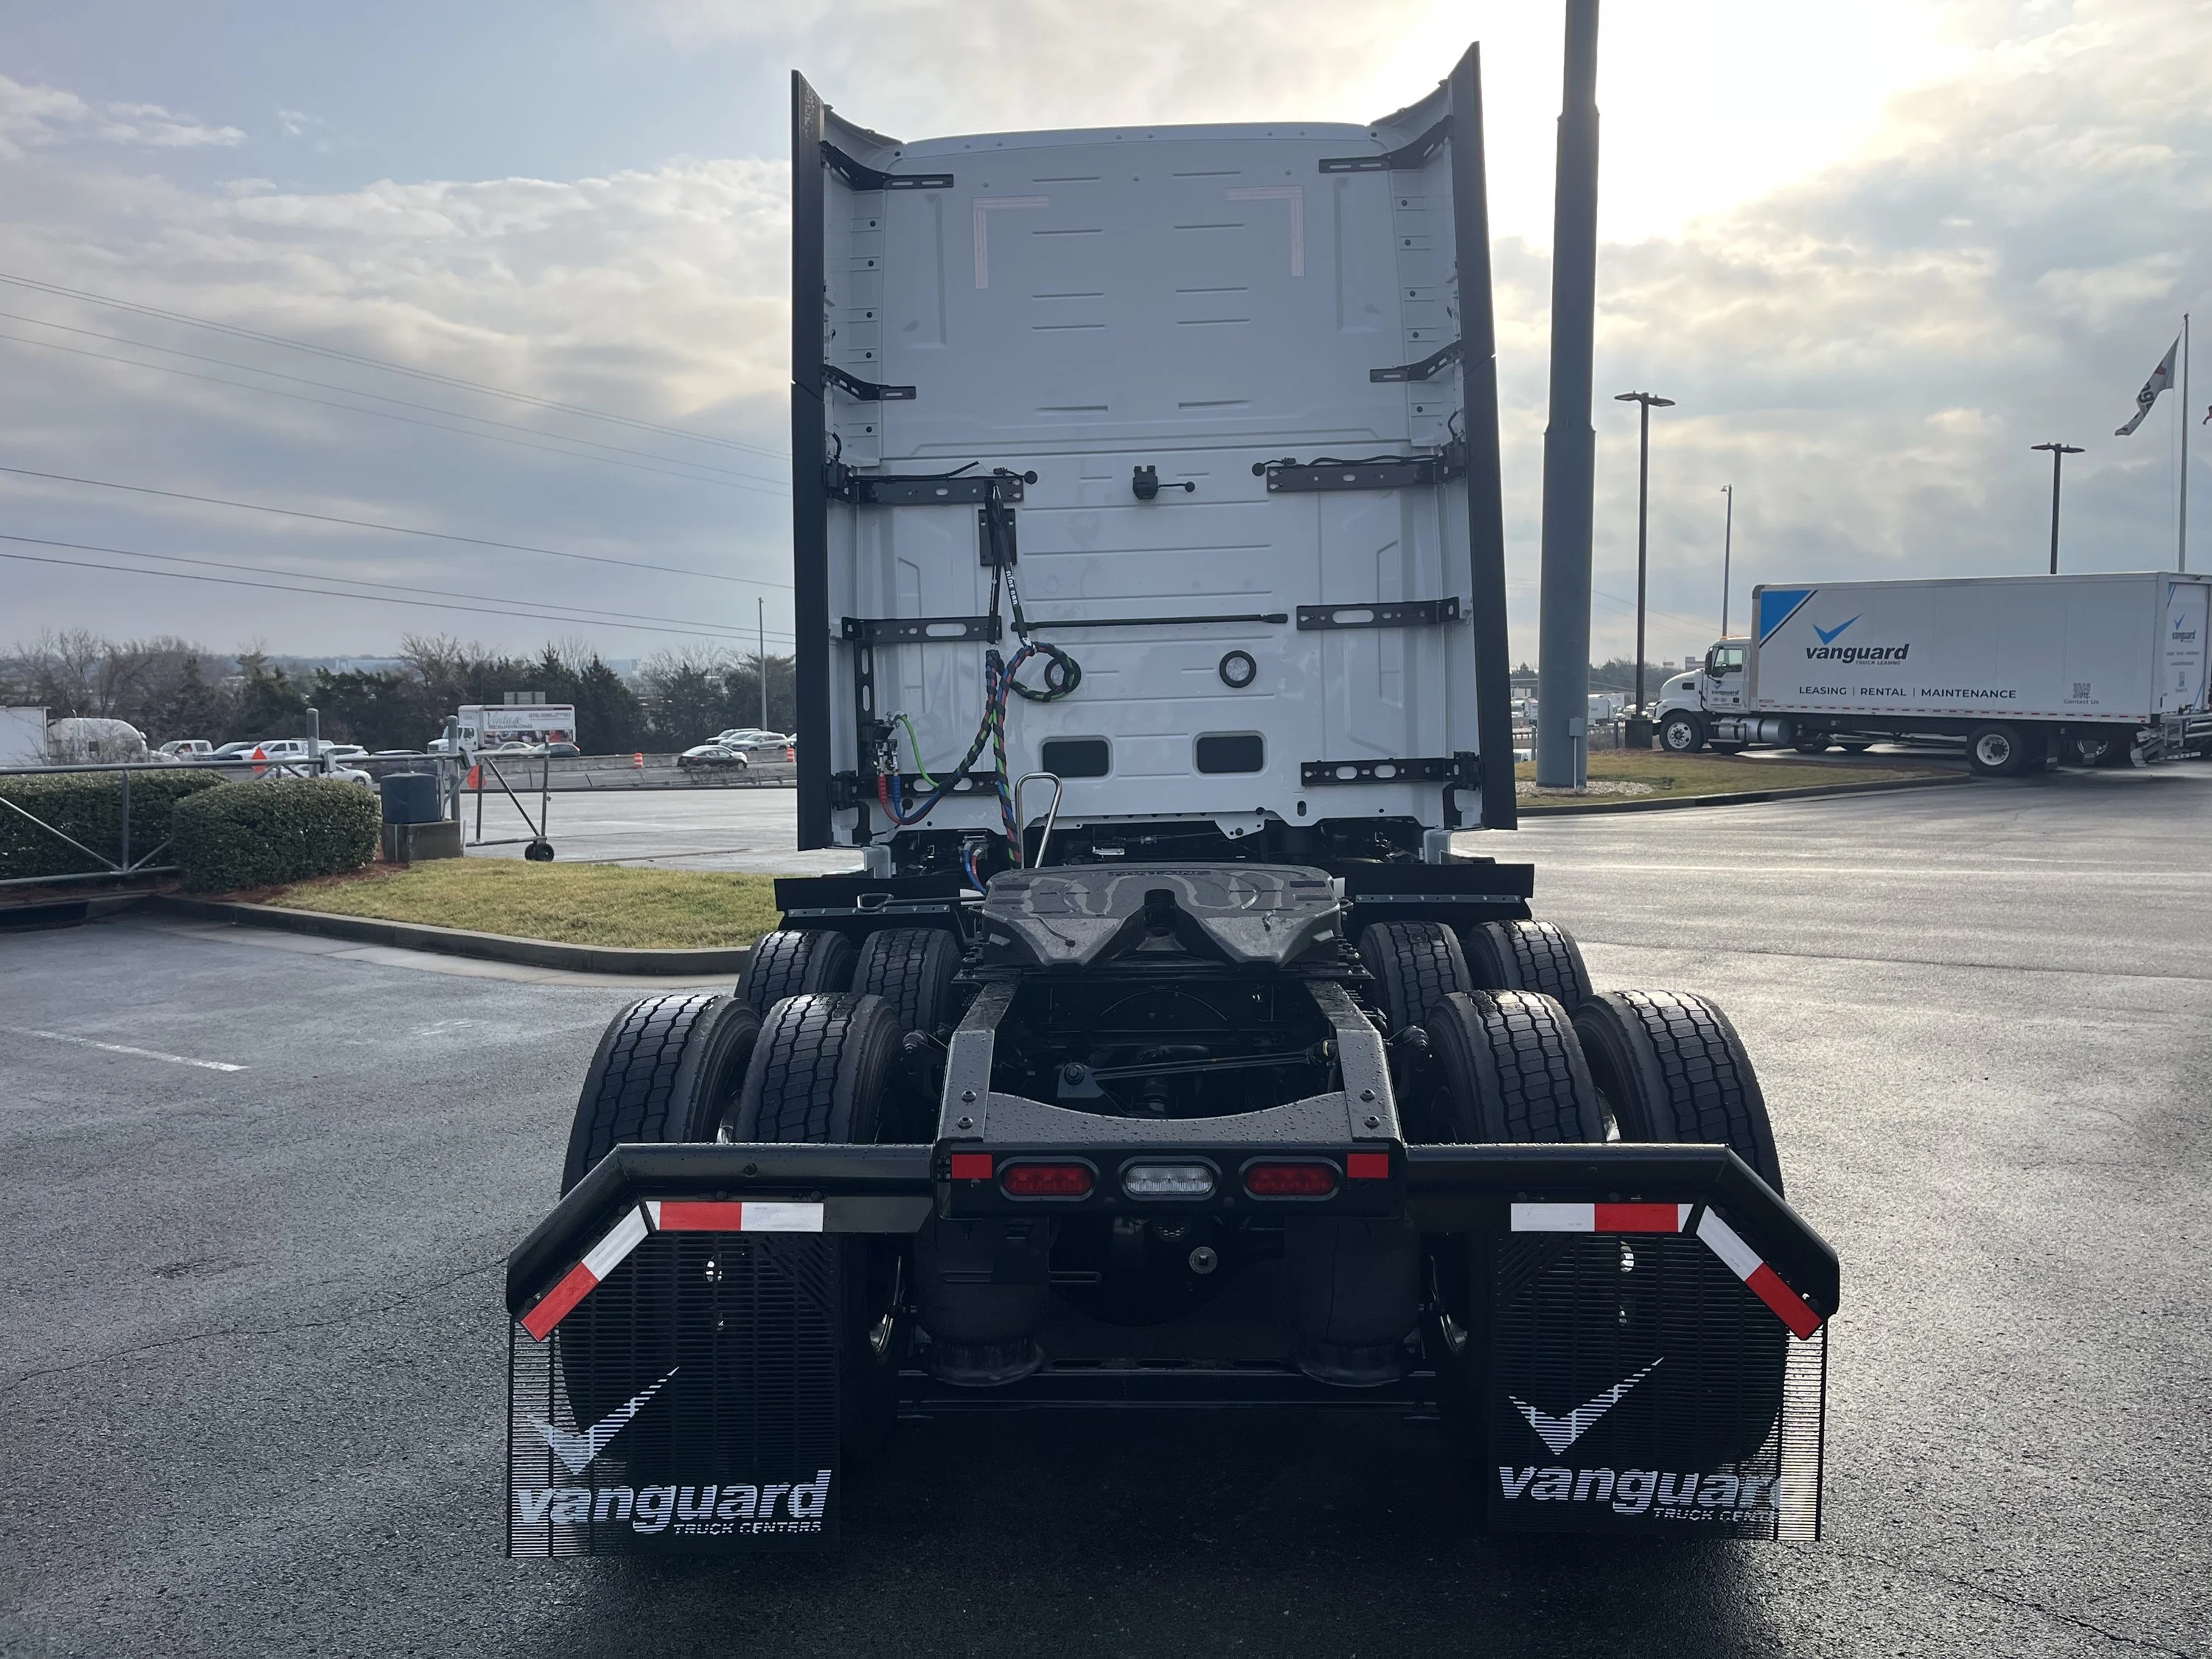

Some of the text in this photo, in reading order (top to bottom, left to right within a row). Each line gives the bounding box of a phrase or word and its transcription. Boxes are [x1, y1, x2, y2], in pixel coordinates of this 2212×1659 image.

[1806, 644, 1910, 664] vanguard
[1799, 686, 2017, 699] LEASING RENTAL MAINTENANCE
[517, 1469, 832, 1534] vanguard
[1654, 1508, 1714, 1520] TRUCK
[673, 1521, 821, 1535] TRUCK CENTERS
